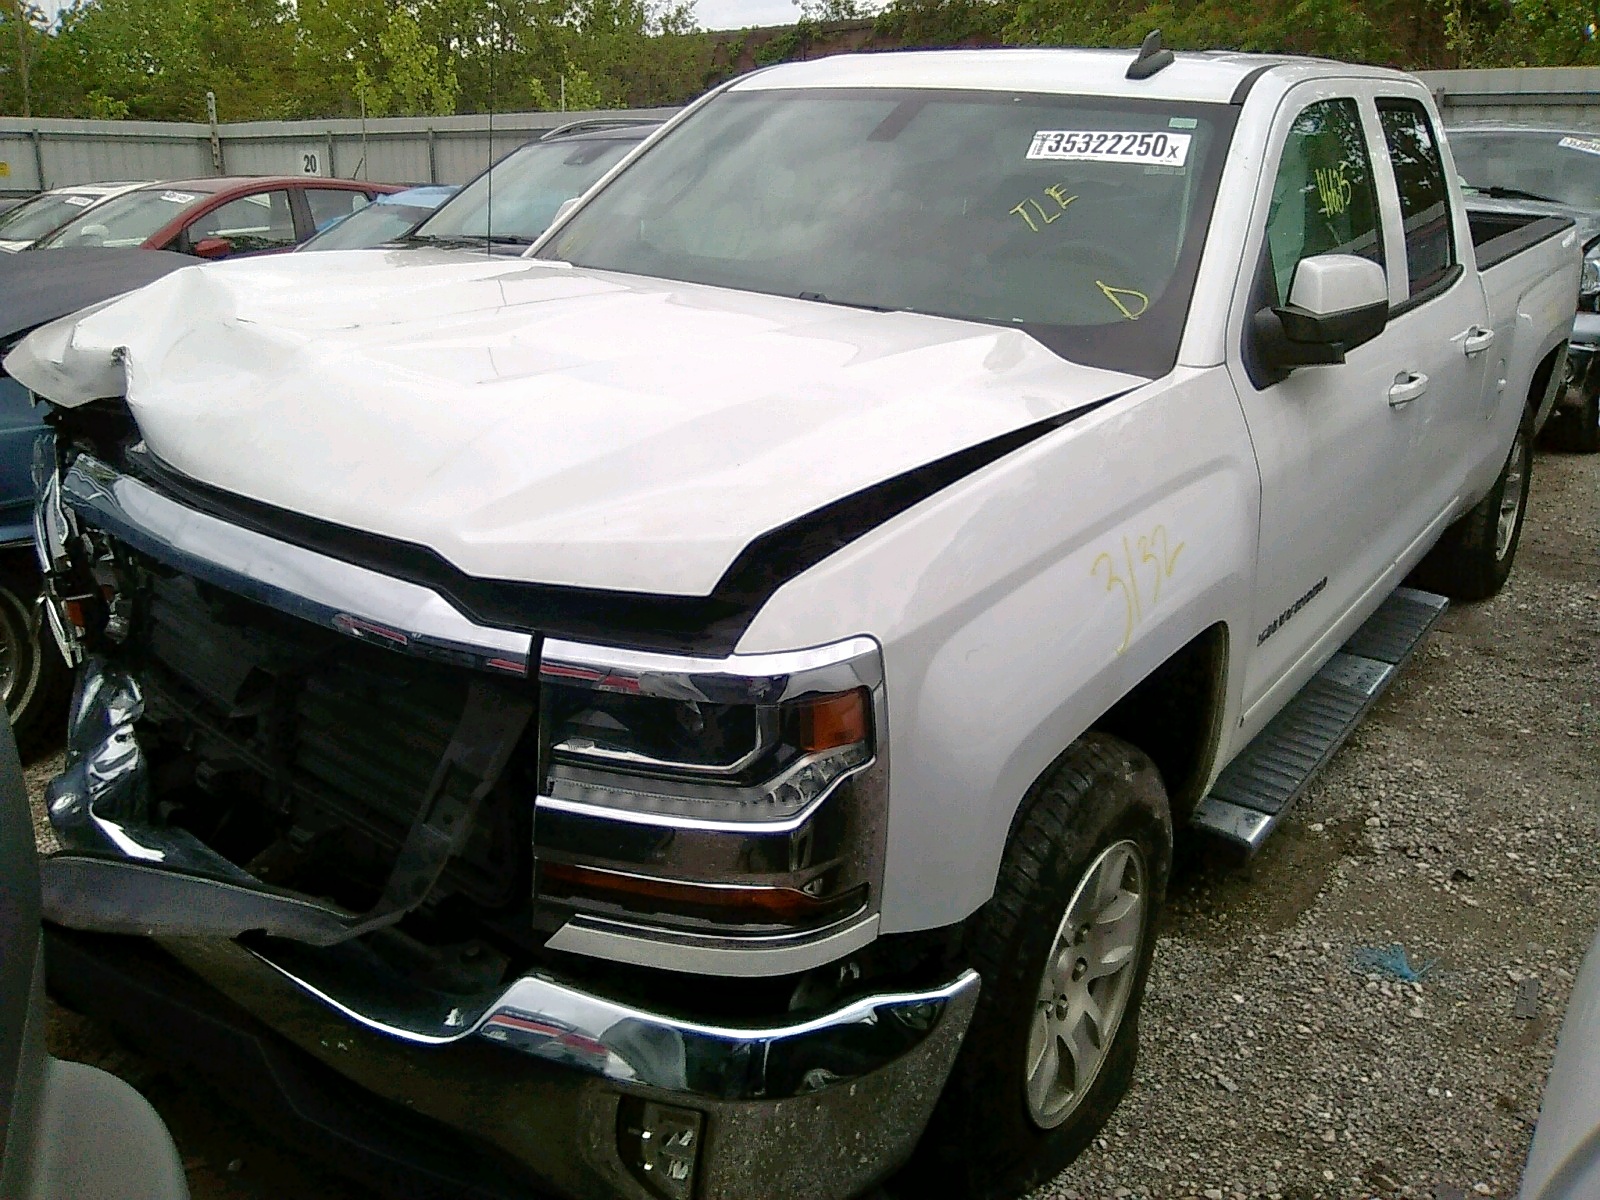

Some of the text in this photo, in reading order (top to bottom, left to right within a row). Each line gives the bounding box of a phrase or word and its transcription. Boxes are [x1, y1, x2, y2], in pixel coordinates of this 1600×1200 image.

[303, 154, 317, 173] 20
[1009, 183, 1079, 232] TLE
[1091, 524, 1185, 656] 3/32
